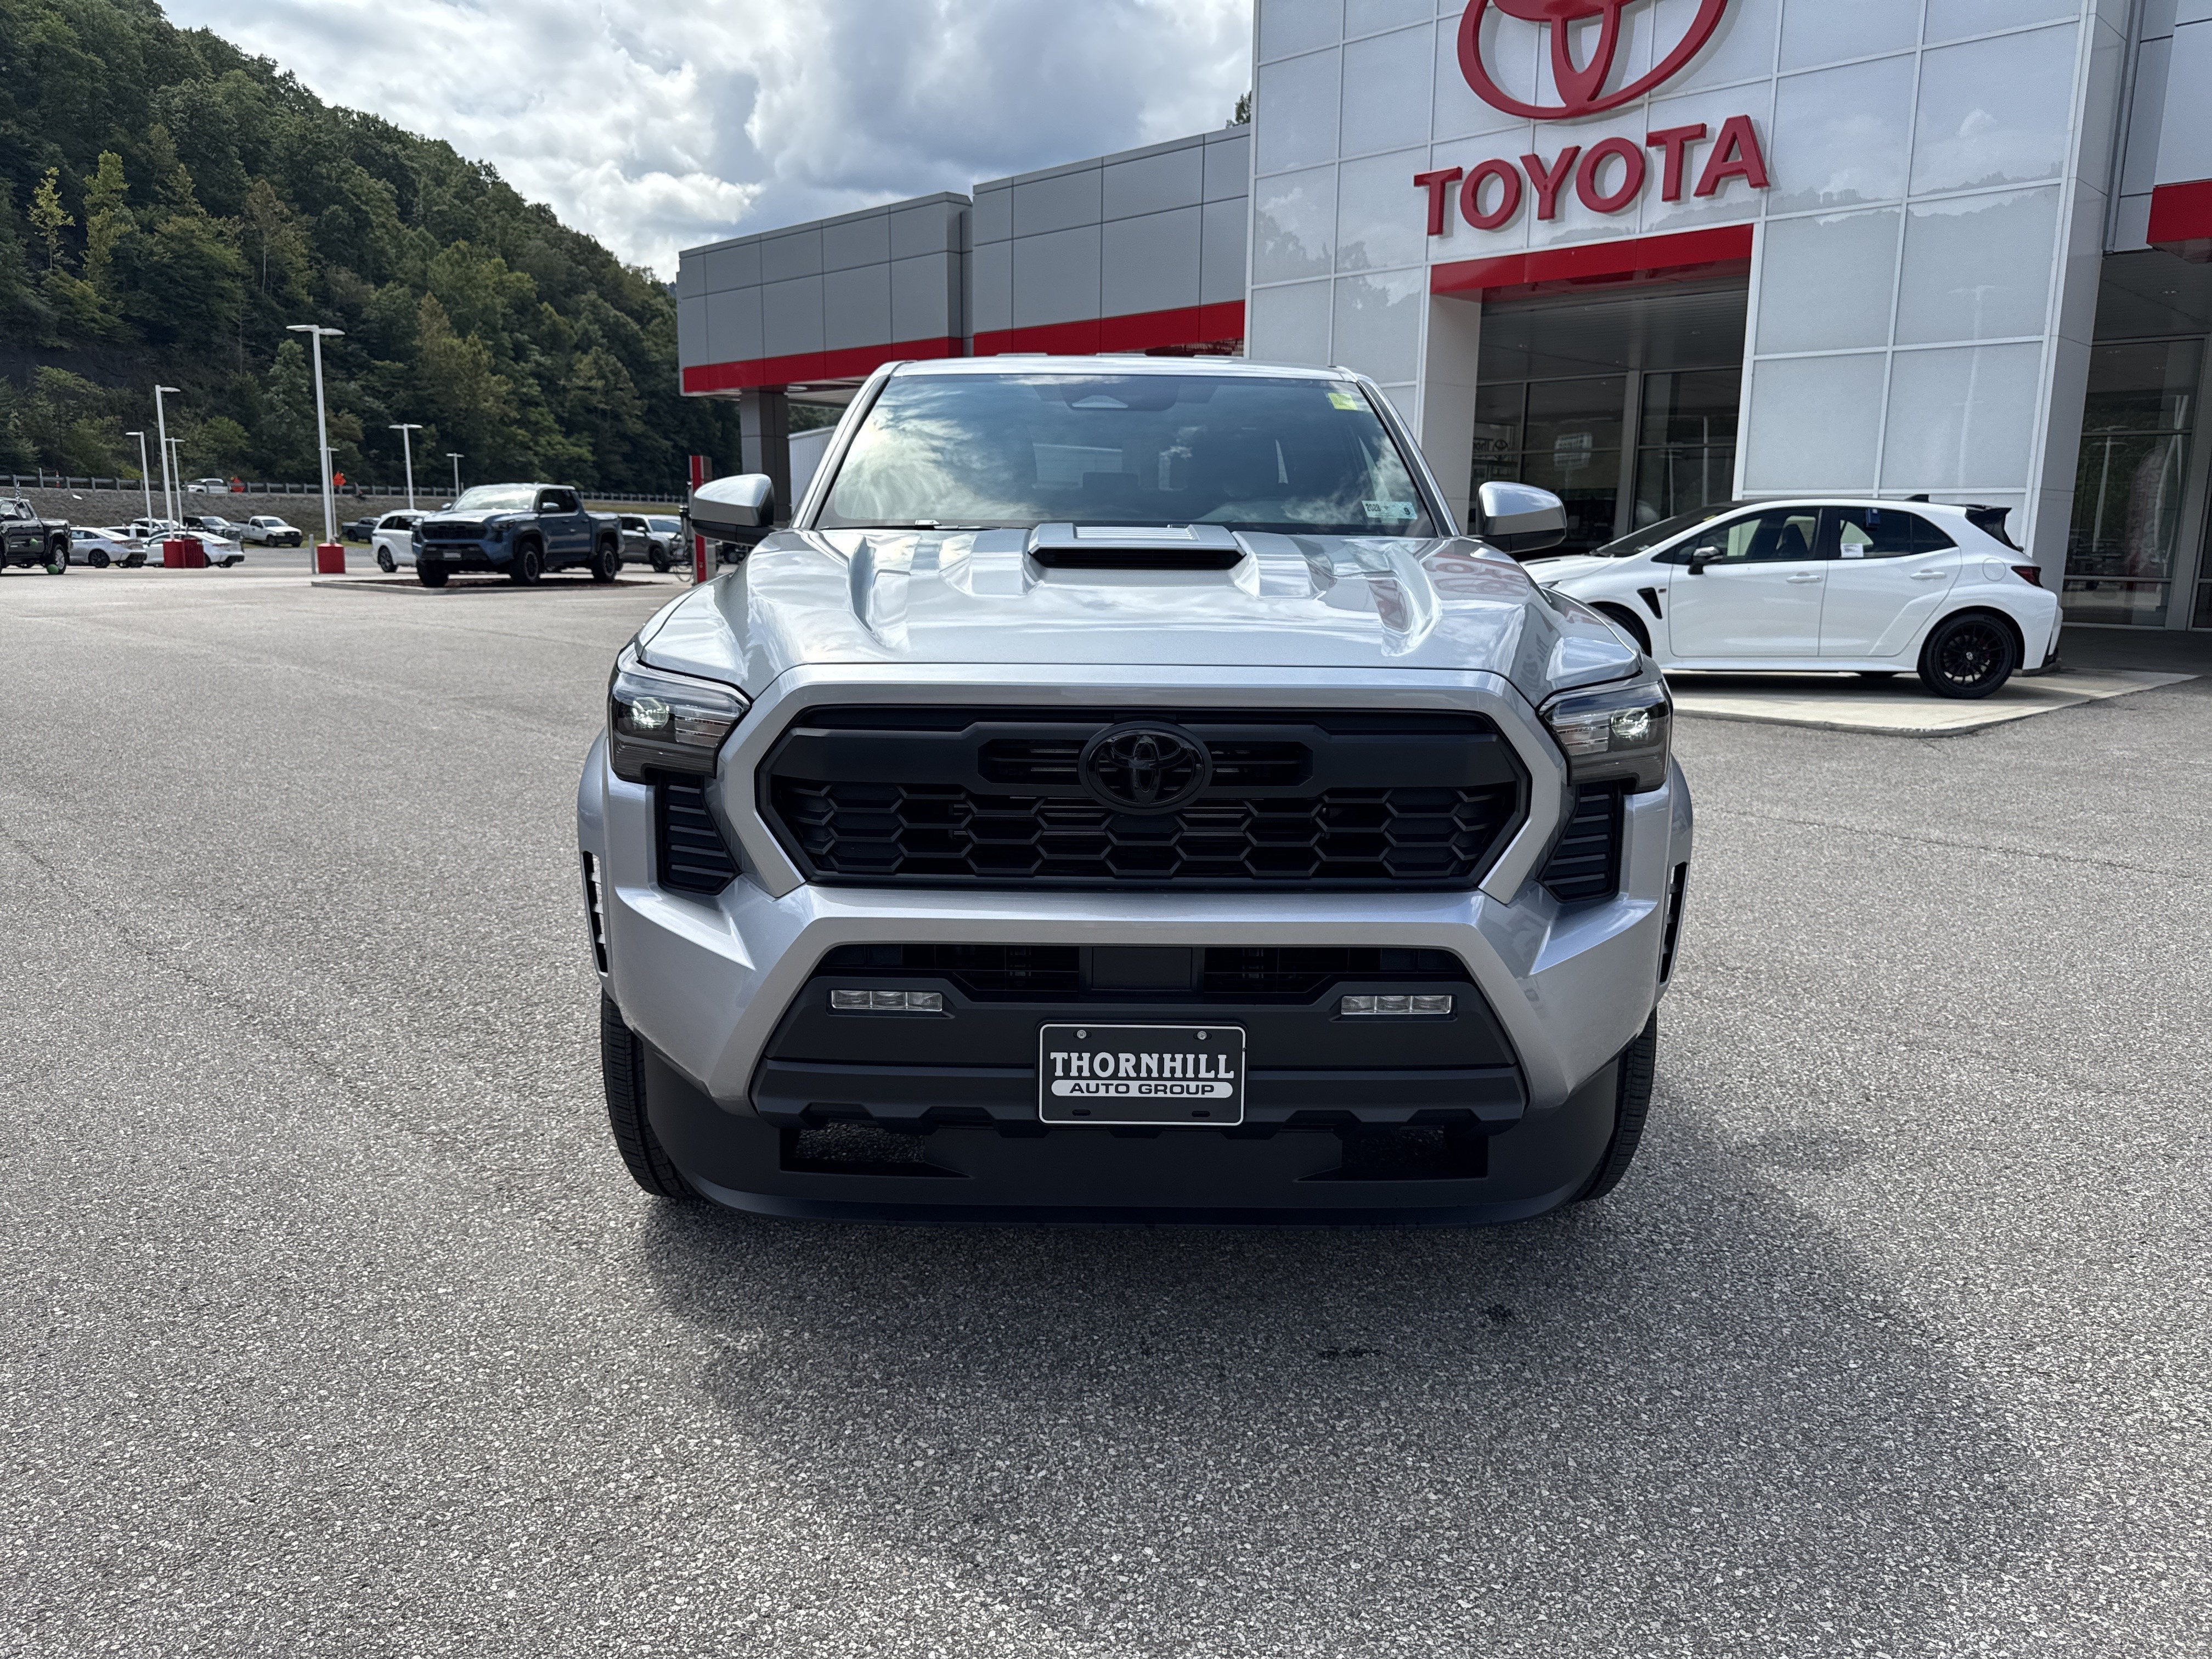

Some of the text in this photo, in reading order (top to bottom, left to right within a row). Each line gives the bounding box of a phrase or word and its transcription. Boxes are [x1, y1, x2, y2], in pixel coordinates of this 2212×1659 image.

[1413, 114, 1770, 236] TOYOTA
[1049, 1052, 1234, 1079] THORNHILL
[1069, 1082, 1215, 1095] AUTO GROUP
